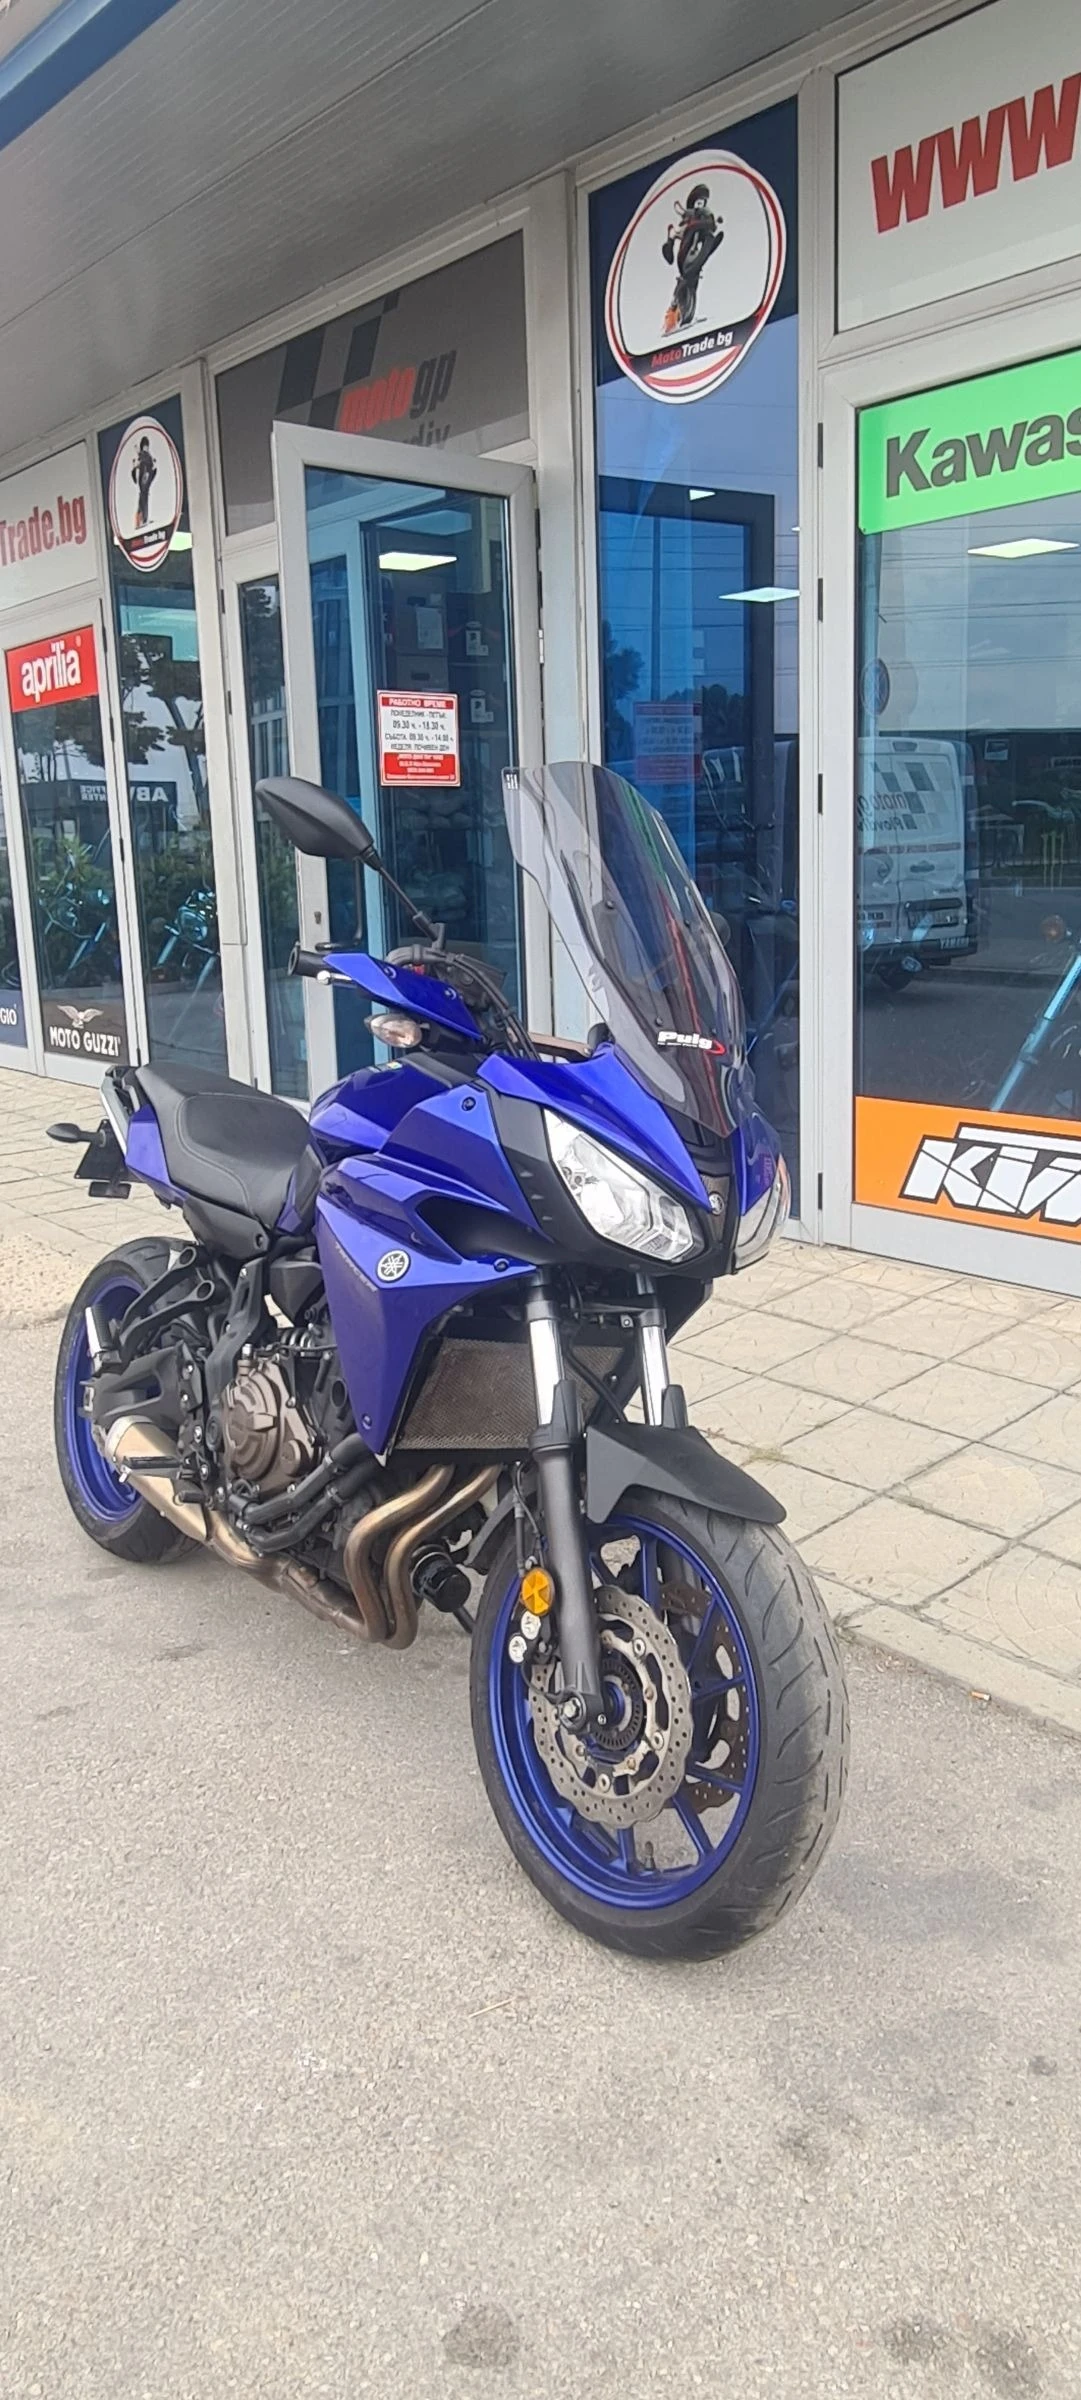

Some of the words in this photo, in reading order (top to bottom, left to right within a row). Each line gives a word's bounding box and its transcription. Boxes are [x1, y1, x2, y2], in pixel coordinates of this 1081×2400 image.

[21, 640, 81, 703] aprilia
[49, 1026, 80, 1050] MOTO
[83, 1031, 119, 1056] GUZZI
